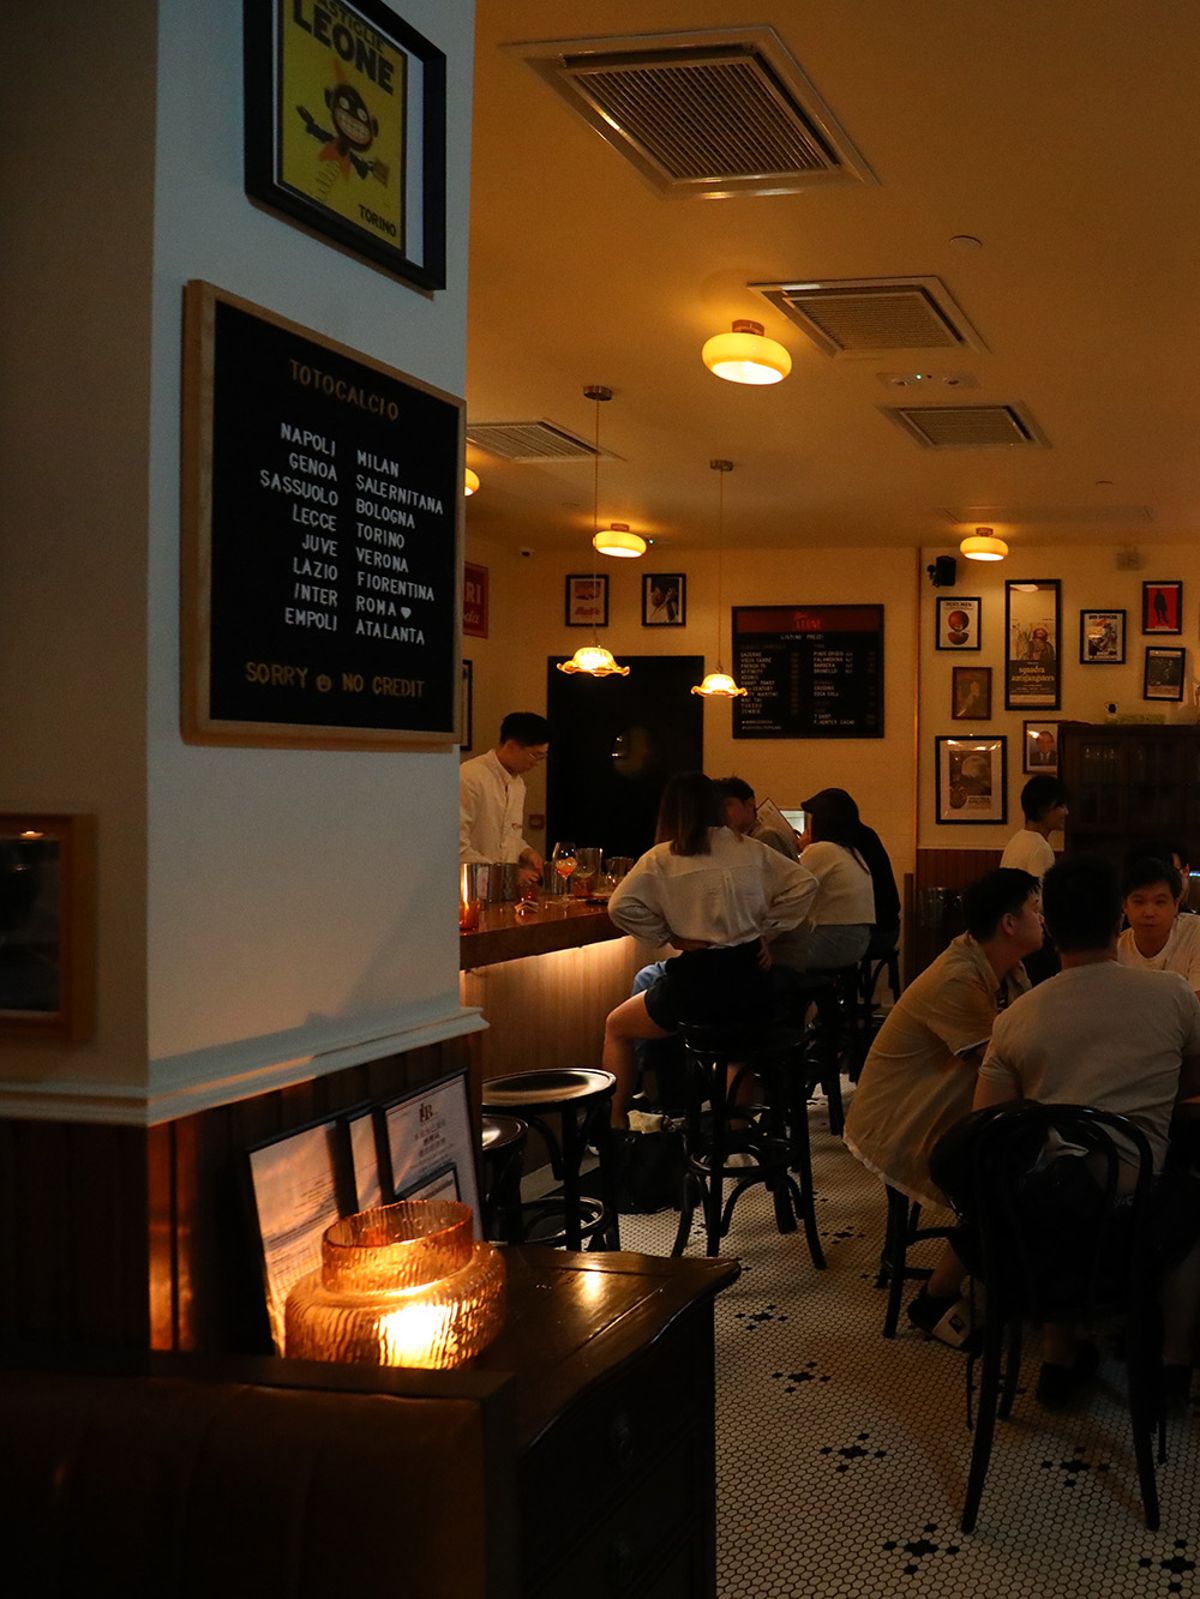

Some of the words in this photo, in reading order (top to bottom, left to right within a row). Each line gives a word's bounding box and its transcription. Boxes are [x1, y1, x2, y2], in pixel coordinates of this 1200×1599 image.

[293, 0, 394, 96] LEONE
[358, 203, 397, 238] TORINO
[289, 357, 400, 422] TOTOCALCIO
[280, 421, 337, 457] NAPOLI
[356, 449, 400, 478] MILAN
[259, 468, 339, 507] SASSUOLO
[355, 498, 416, 530] BOLOGNA
[288, 452, 338, 482] GENOA
[355, 473, 444, 516] SALERNITANA
[292, 503, 337, 533] LECCE
[355, 522, 406, 550] TORINO
[301, 534, 338, 557] JUVE
[355, 546, 409, 574] VERONA
[292, 556, 339, 582] LAZIO
[356, 571, 435, 602] FIORENTINA
[293, 582, 338, 608] INTER
[355, 595, 397, 617] ROMA
[465, 581, 482, 605] RI
[284, 606, 338, 632] EMPOLI
[355, 618, 426, 646] ATALANTA
[244, 660, 309, 689] SORRY
[341, 673, 365, 694] NO
[371, 675, 426, 699] CREDIT
